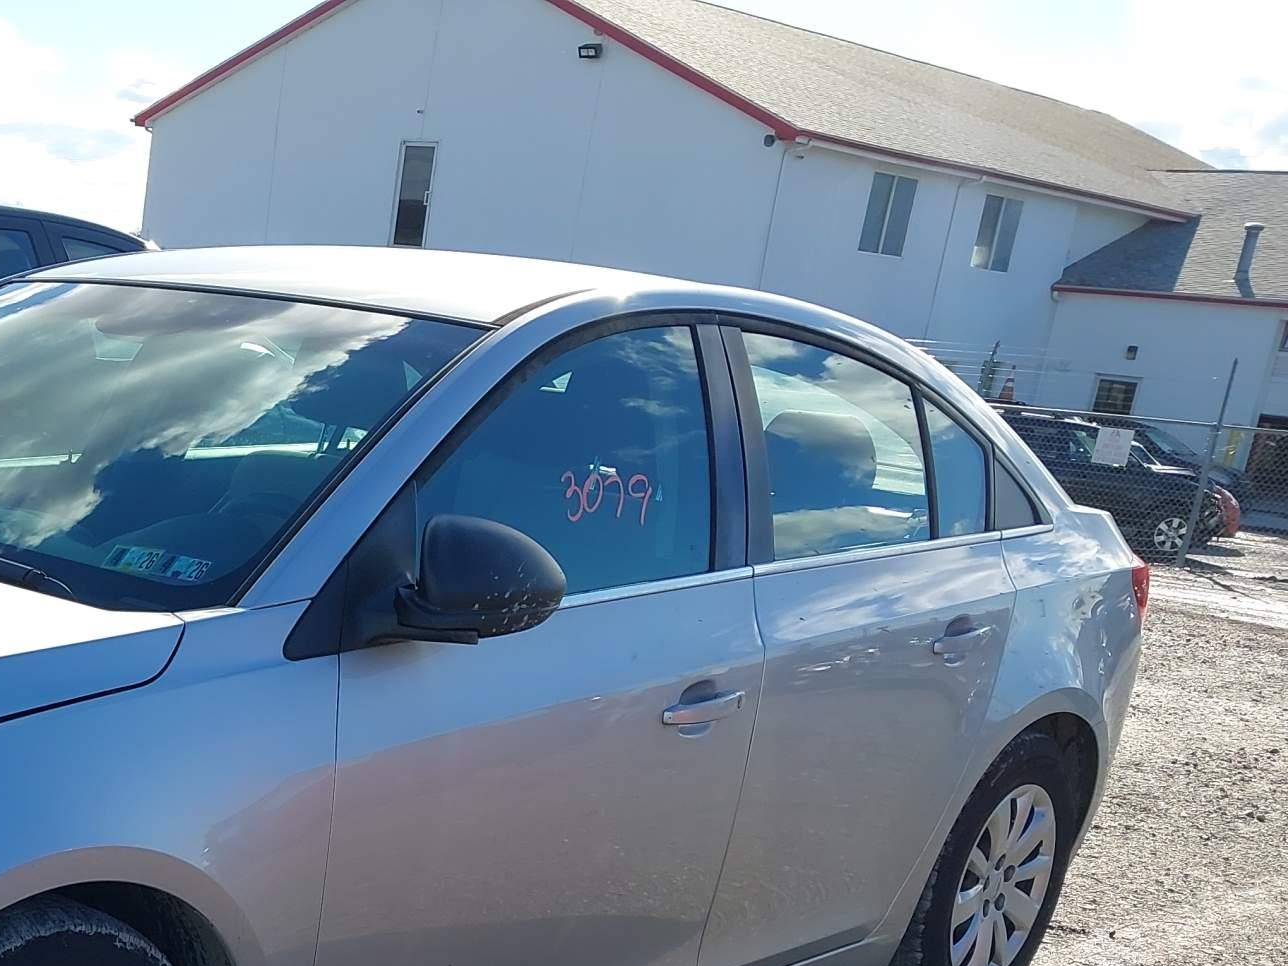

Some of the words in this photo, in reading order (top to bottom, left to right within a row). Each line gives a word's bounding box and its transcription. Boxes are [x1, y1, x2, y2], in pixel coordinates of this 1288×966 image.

[561, 470, 653, 527] 3079
[138, 551, 160, 570] 26
[187, 560, 210, 580] 26
